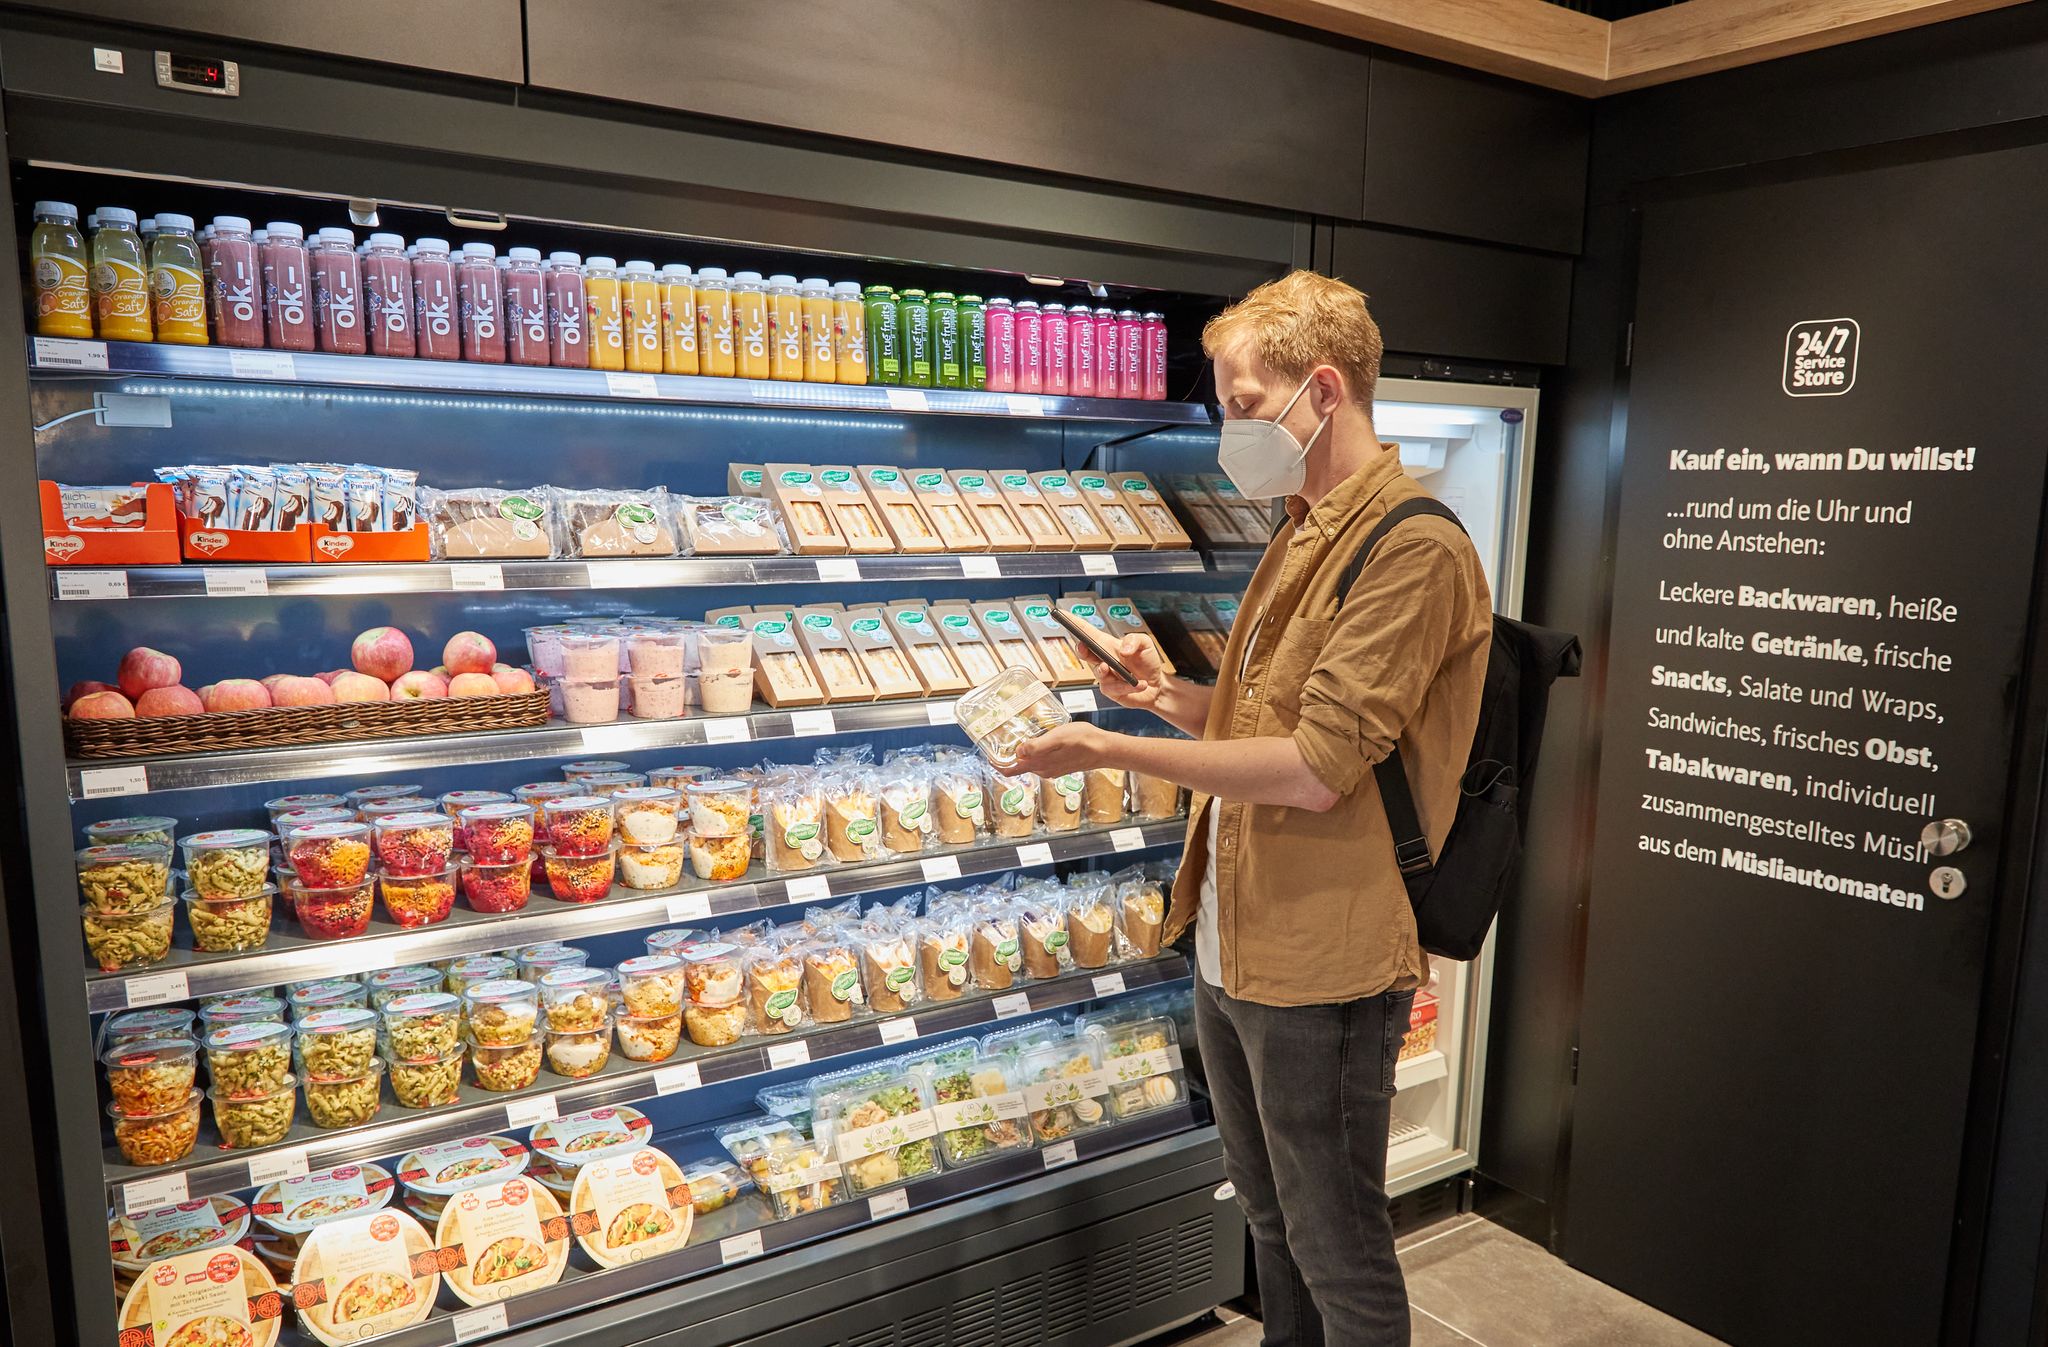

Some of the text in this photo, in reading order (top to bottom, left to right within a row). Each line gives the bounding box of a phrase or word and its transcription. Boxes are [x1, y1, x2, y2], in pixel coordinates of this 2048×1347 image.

[61, 297, 85, 310] Saft
[117, 300, 142, 313] Saft
[175, 305, 199, 318] Saft
[880, 304, 891, 332] fruits
[882, 333, 892, 356] true
[911, 308, 923, 358] true fruits
[941, 310, 952, 361] true fruits
[970, 313, 981, 363] true fruits
[1001, 316, 1010, 364] true fruits
[1028, 318, 1037, 366] true fruits
[1053, 321, 1062, 368] true fruits
[1080, 323, 1089, 369] true fruits
[1107, 325, 1116, 350] fruits
[1128, 327, 1137, 373] true fruits
[1155, 329, 1164, 374] true fruits
[1796, 326, 1849, 358] 24/7
[1792, 368, 1845, 387] Store
[1794, 354, 1846, 371] Service
[1669, 446, 1976, 474] Kauf ein, wann Du willst!
[62, 501, 97, 510] chnitte
[1666, 497, 1912, 524] ...rund um die Uhr und
[1662, 528, 1825, 555] ohne Anstehen:
[1659, 579, 1958, 624] Leckere Backwaren, heiße
[1655, 624, 1952, 672] und kalte Getränke, frische
[1651, 665, 1945, 724] Snacks, Salate und Wraps,
[1647, 706, 1939, 773] Sandwiches, frisches Obst,
[1645, 748, 1936, 817] Tabakwaren, individuell
[1641, 792, 1855, 850] zusammengestelltes
[1638, 833, 1925, 911] aus dem Müsliautomaten
